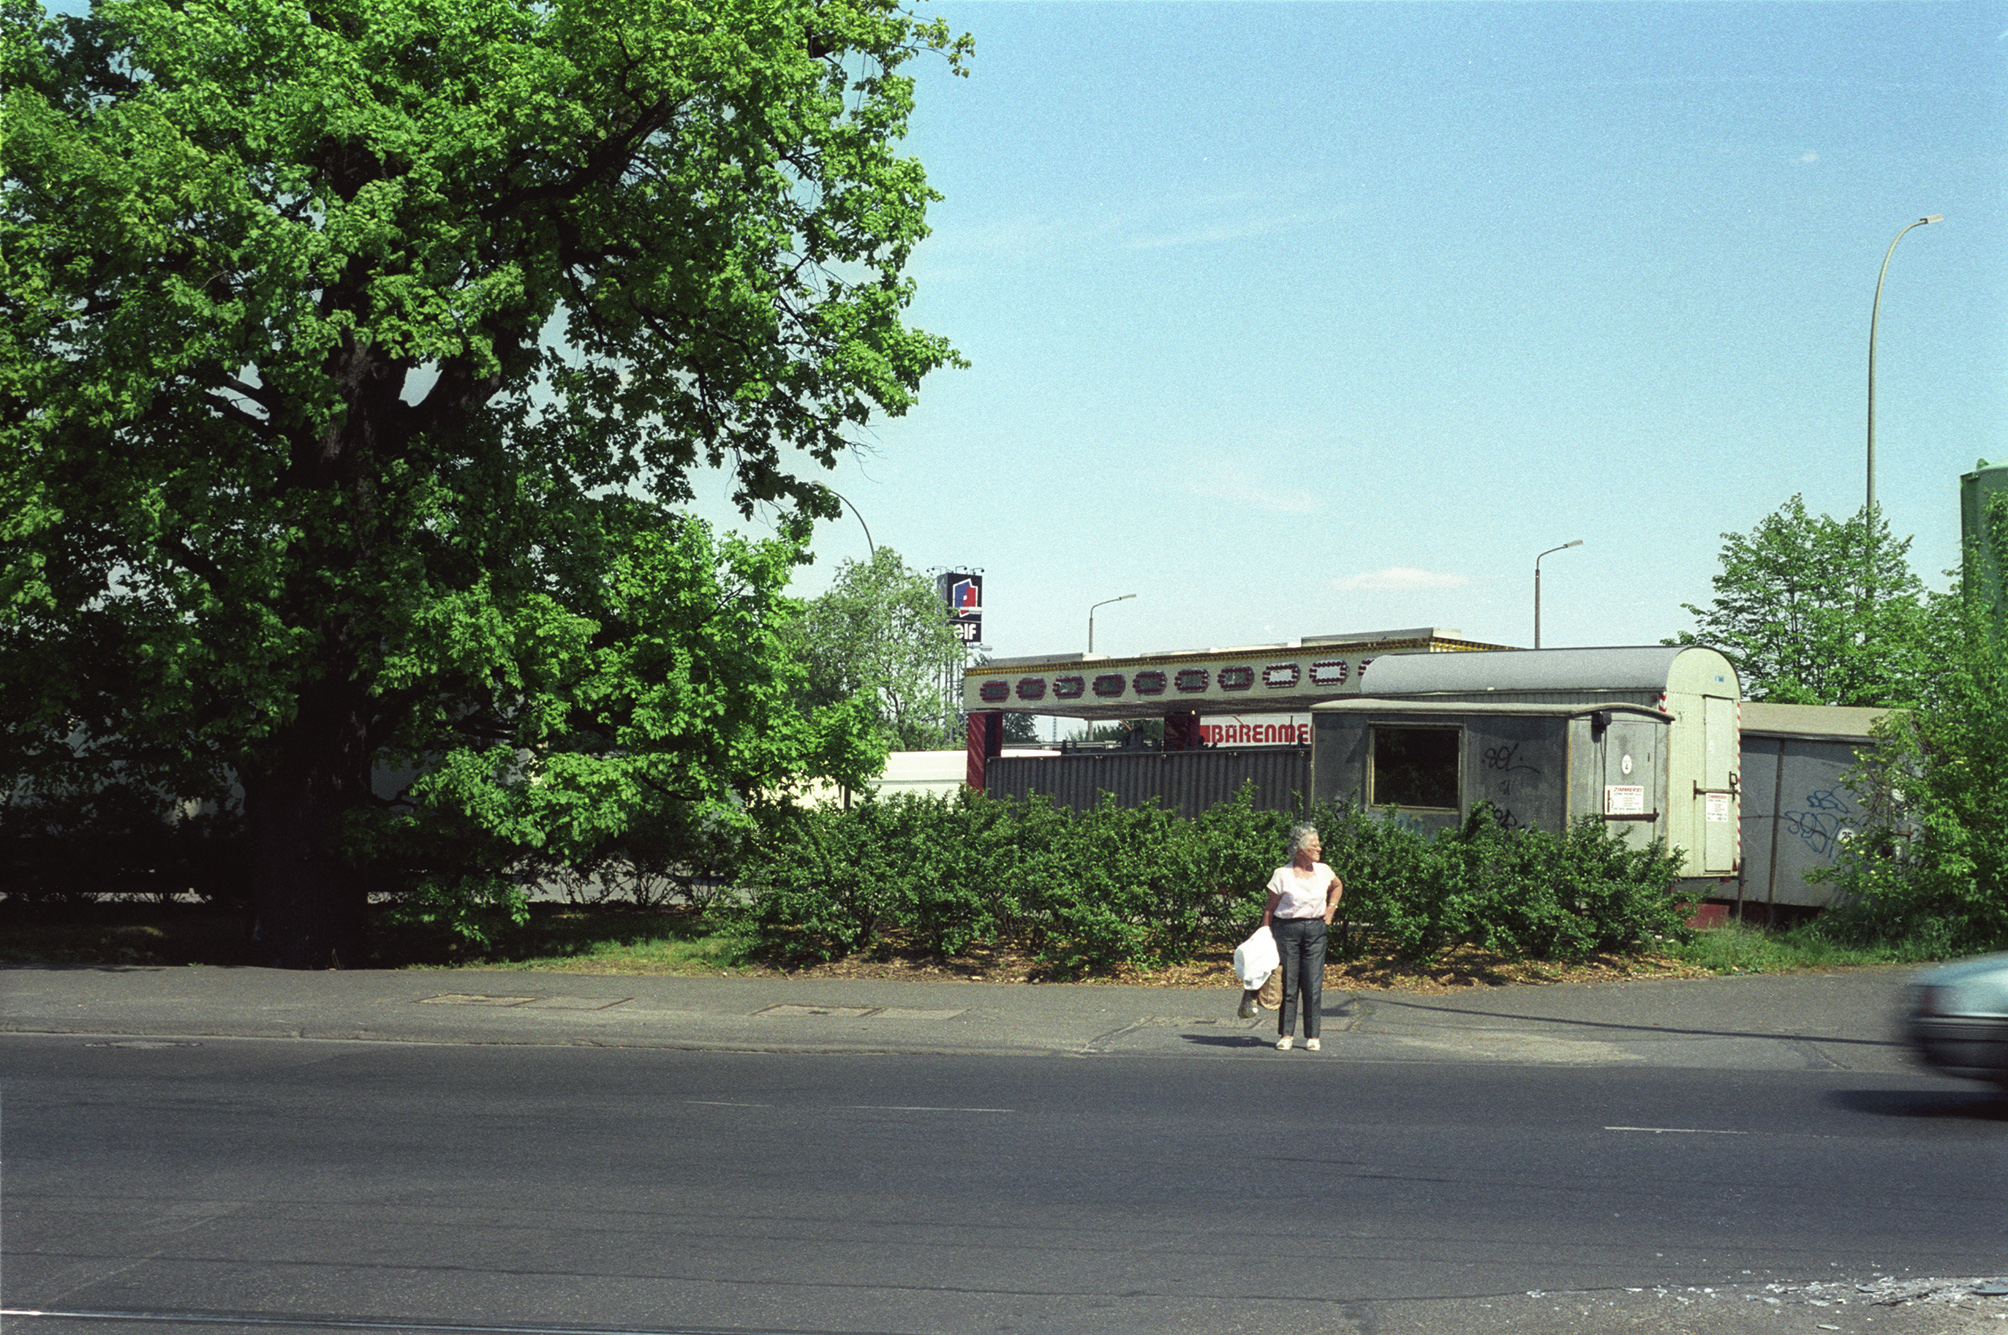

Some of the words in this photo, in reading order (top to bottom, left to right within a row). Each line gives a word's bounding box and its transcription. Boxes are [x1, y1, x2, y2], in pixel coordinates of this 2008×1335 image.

[953, 623, 977, 640] elf
[1210, 723, 1313, 744] BÄRENME
[1841, 831, 1853, 842] 25
